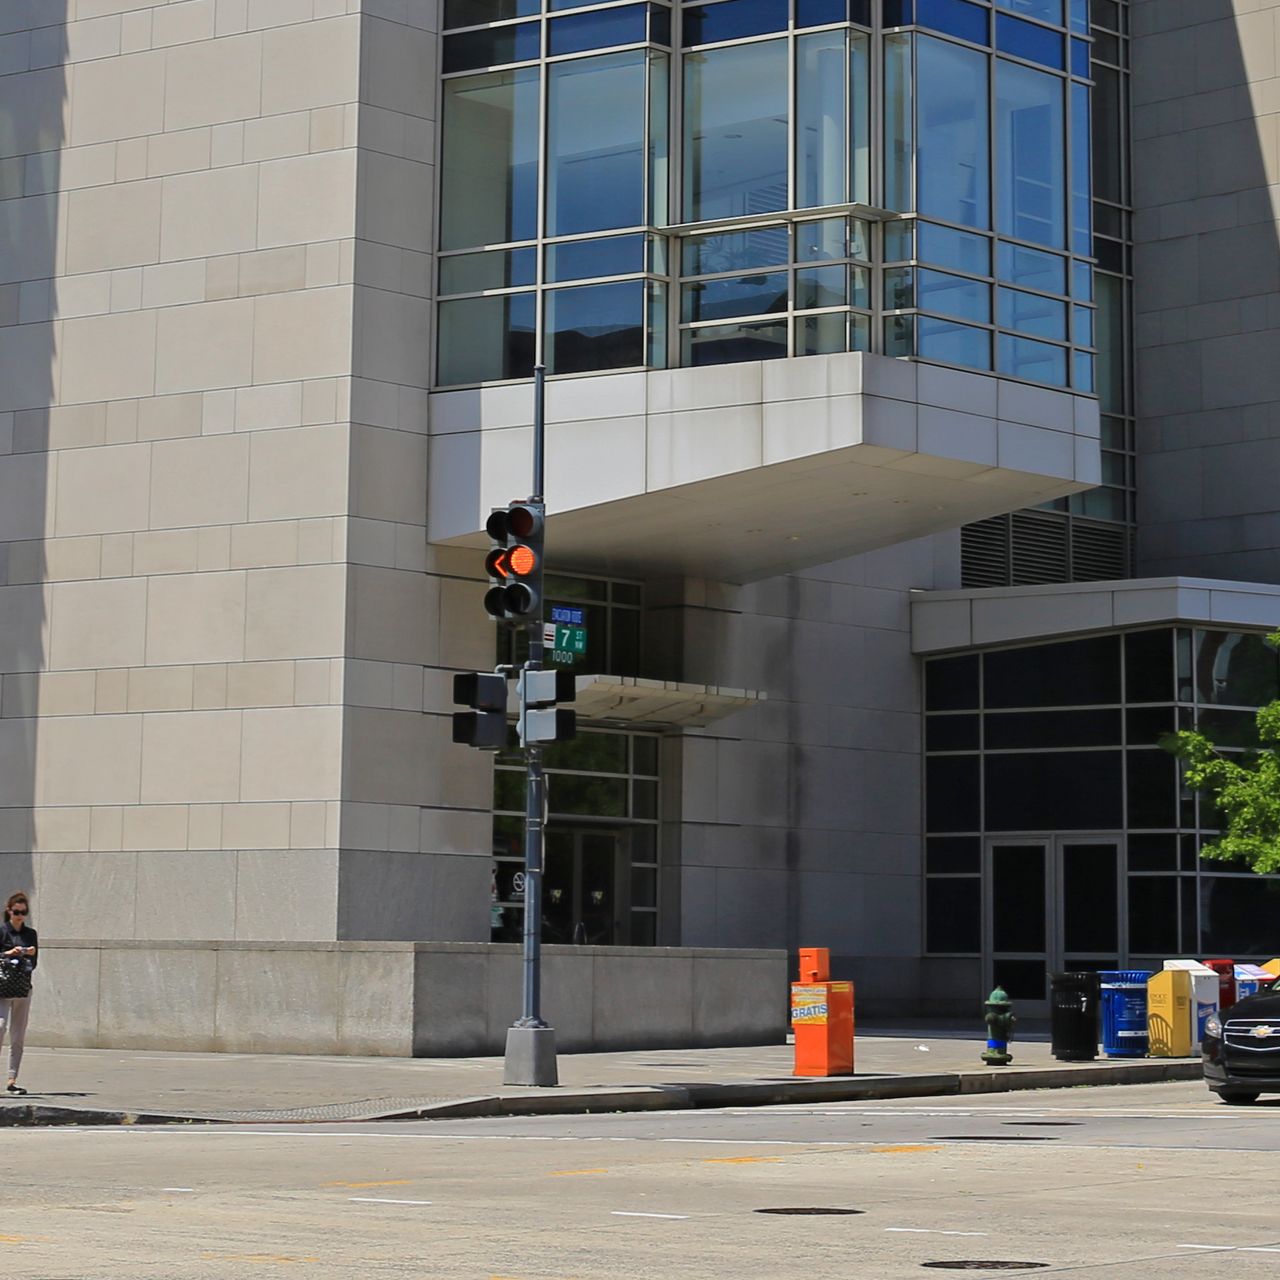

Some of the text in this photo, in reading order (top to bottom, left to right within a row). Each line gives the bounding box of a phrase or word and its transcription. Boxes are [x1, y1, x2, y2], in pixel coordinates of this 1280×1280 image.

[561, 629, 570, 647] 7
[552, 650, 573, 663] 1000
[792, 1004, 827, 1018] GRATIS
